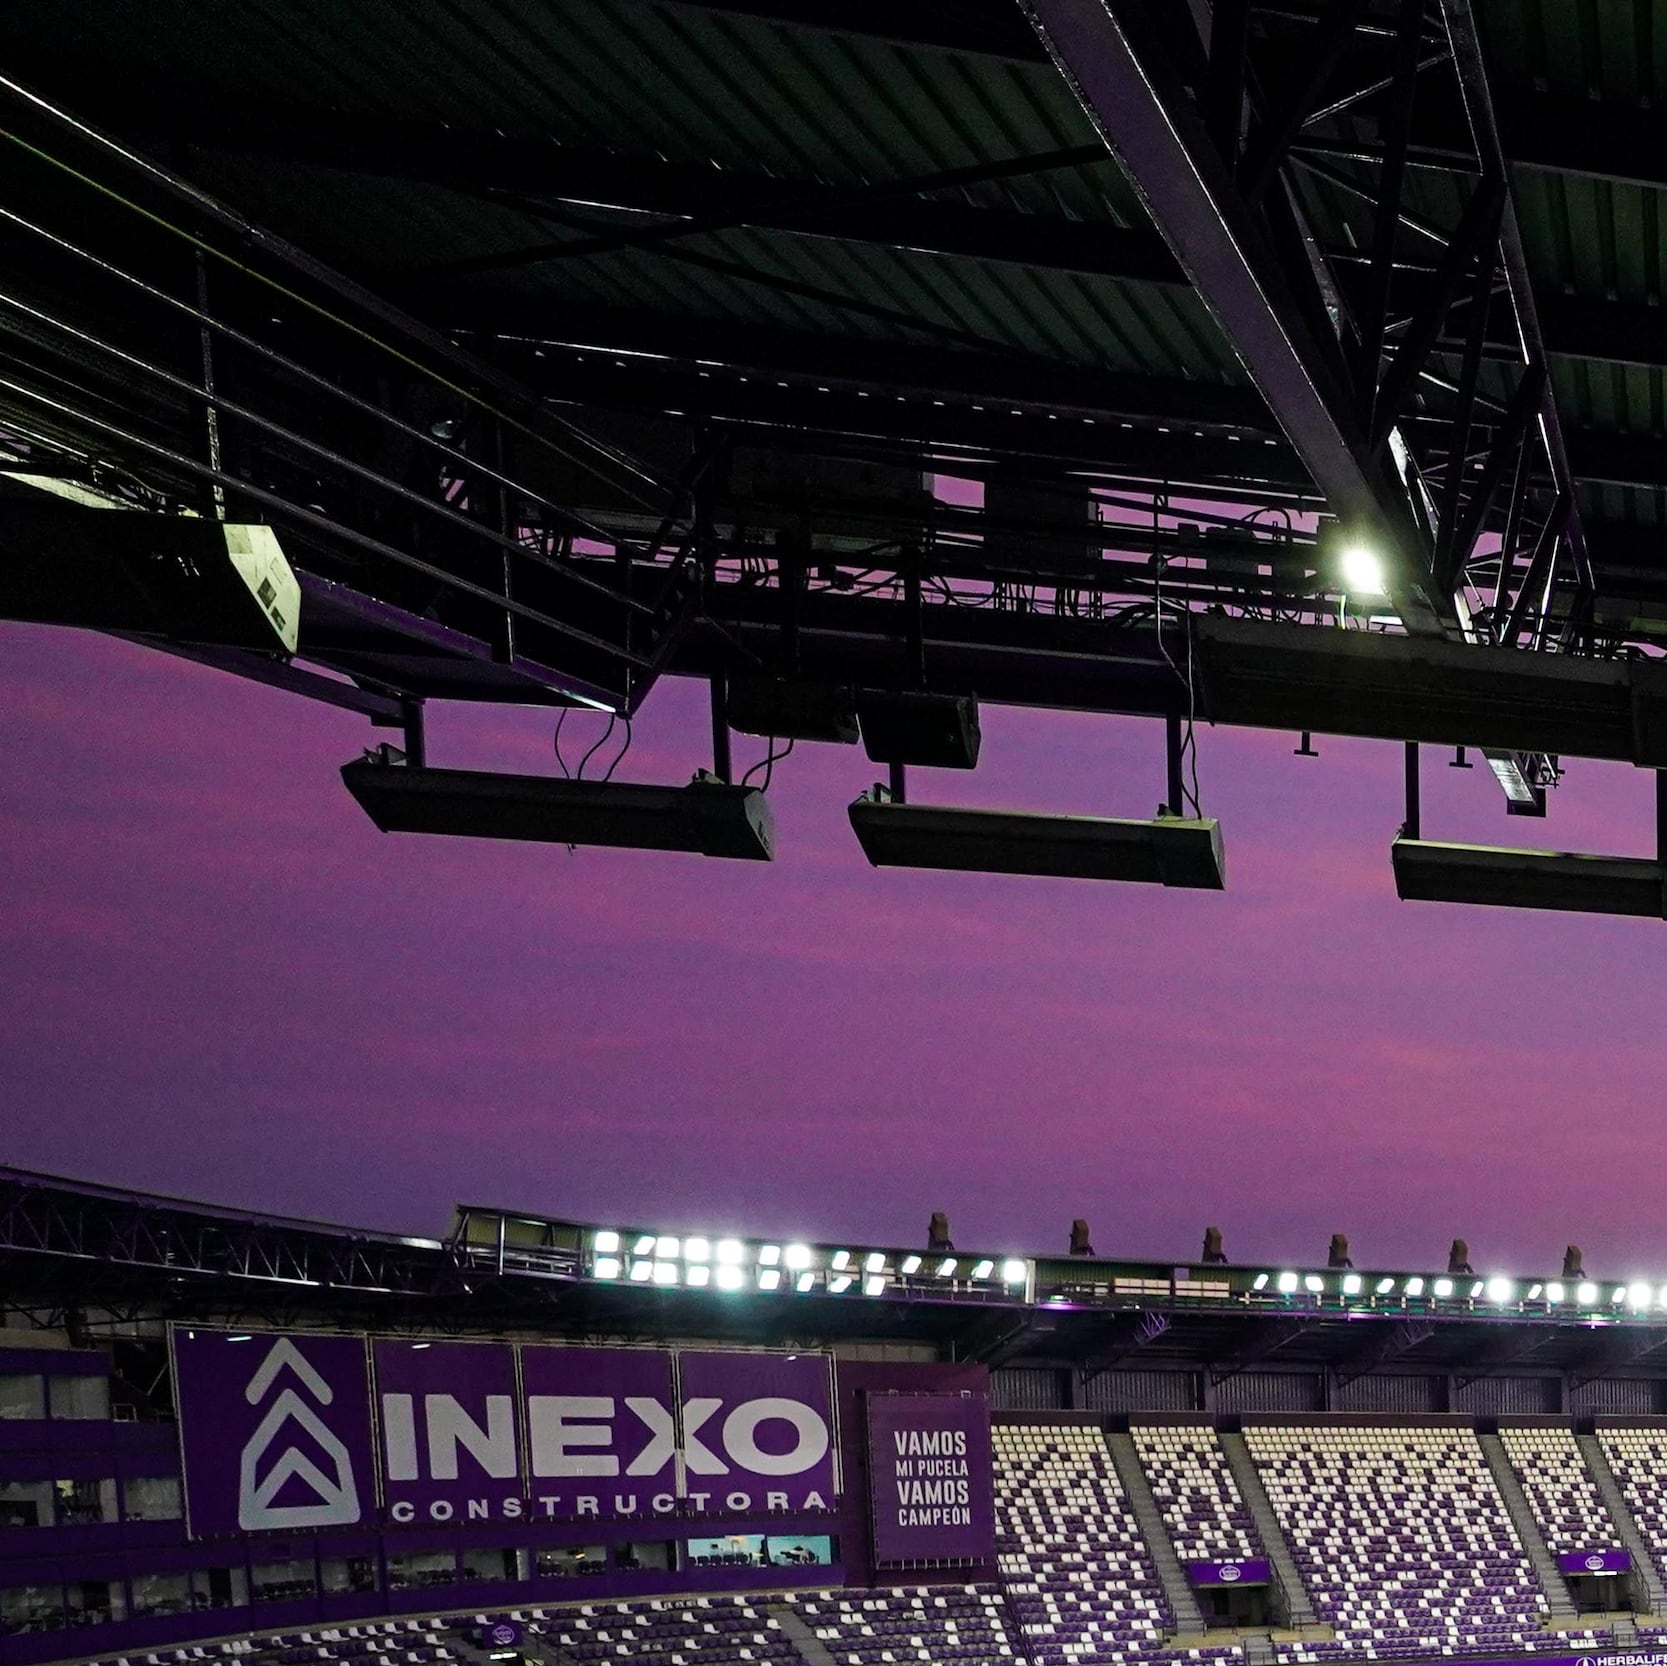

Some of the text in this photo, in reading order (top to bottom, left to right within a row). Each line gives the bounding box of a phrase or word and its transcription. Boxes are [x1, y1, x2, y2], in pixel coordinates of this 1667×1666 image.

[382, 1394, 829, 1480] INEXO
[894, 1431, 966, 1456] VAMOS
[896, 1460, 968, 1476] MI PUCELA
[897, 1480, 969, 1505] VAMOS
[392, 1491, 827, 1522] CONSTRUCTORA
[898, 1506, 971, 1526] CAMPEÓN
